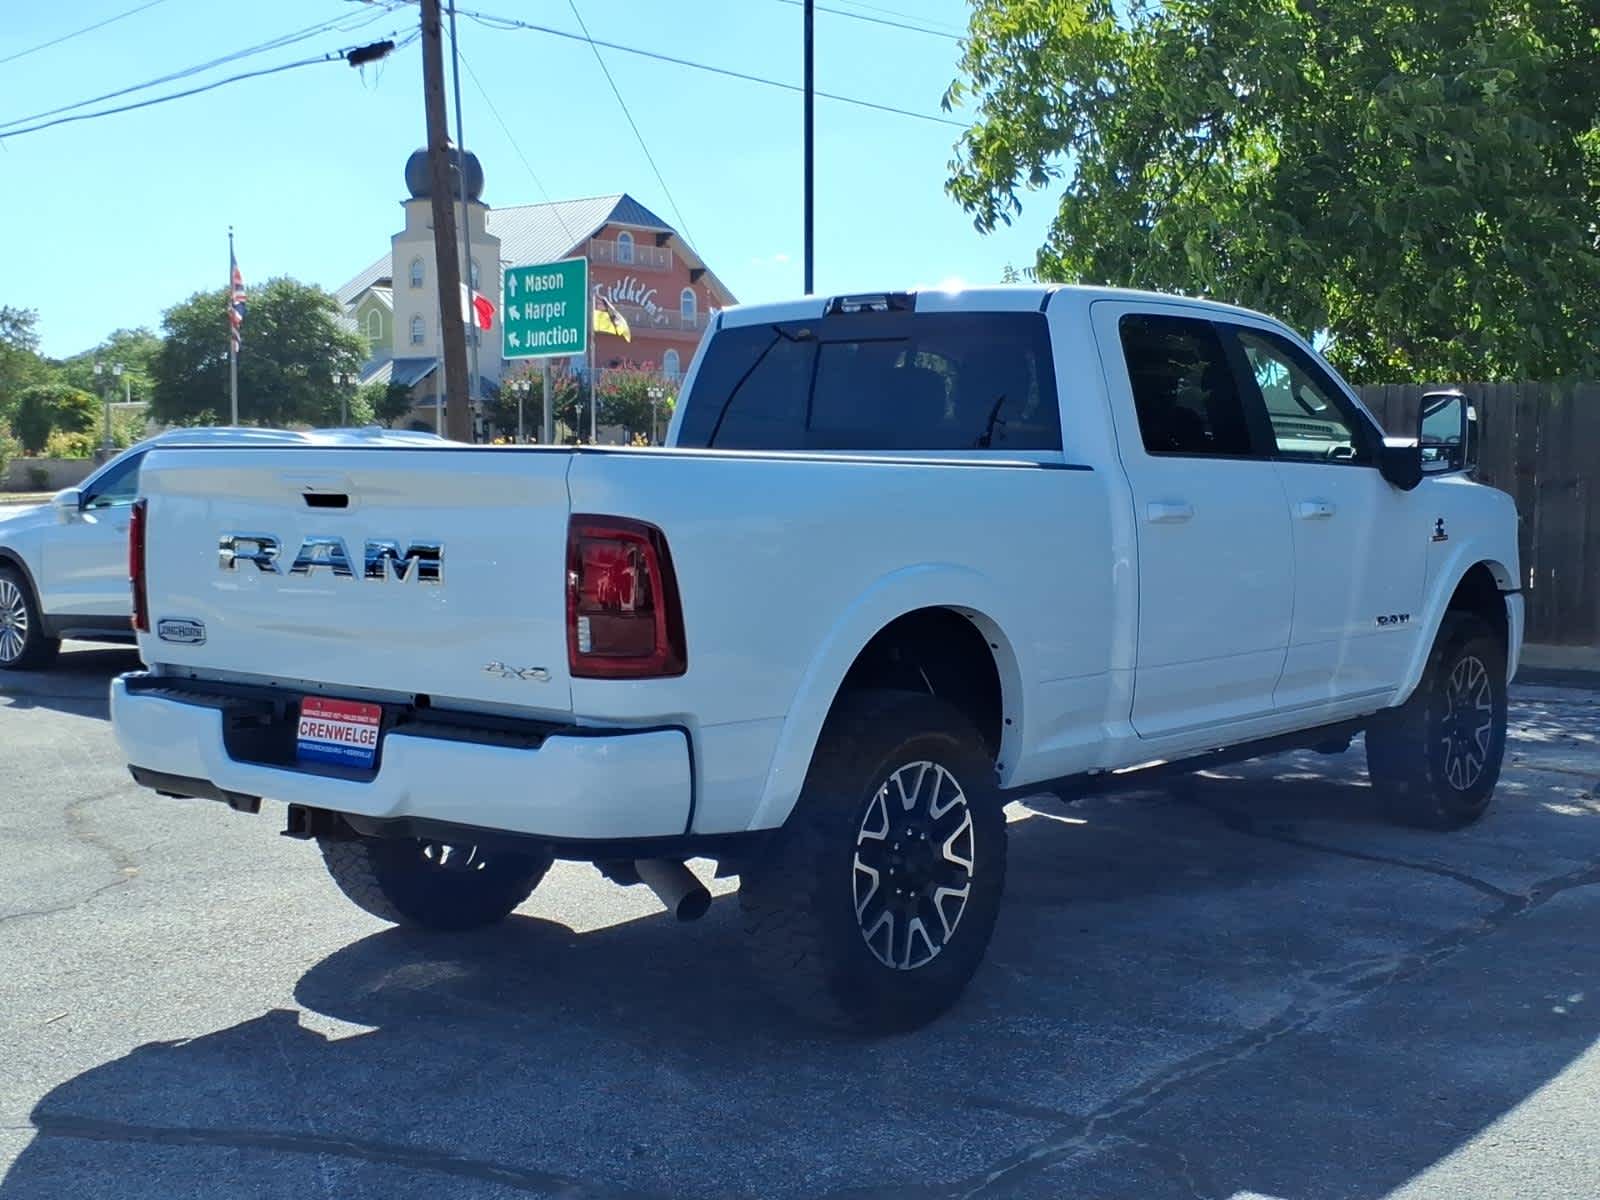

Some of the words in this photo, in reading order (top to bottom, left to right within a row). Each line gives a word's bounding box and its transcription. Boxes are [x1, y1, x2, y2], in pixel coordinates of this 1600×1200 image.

[525, 273, 564, 293] Mason
[525, 301, 567, 323] Harper
[525, 326, 578, 348] Junction
[219, 530, 446, 585] RAM
[300, 721, 377, 745] CRENWELGE
